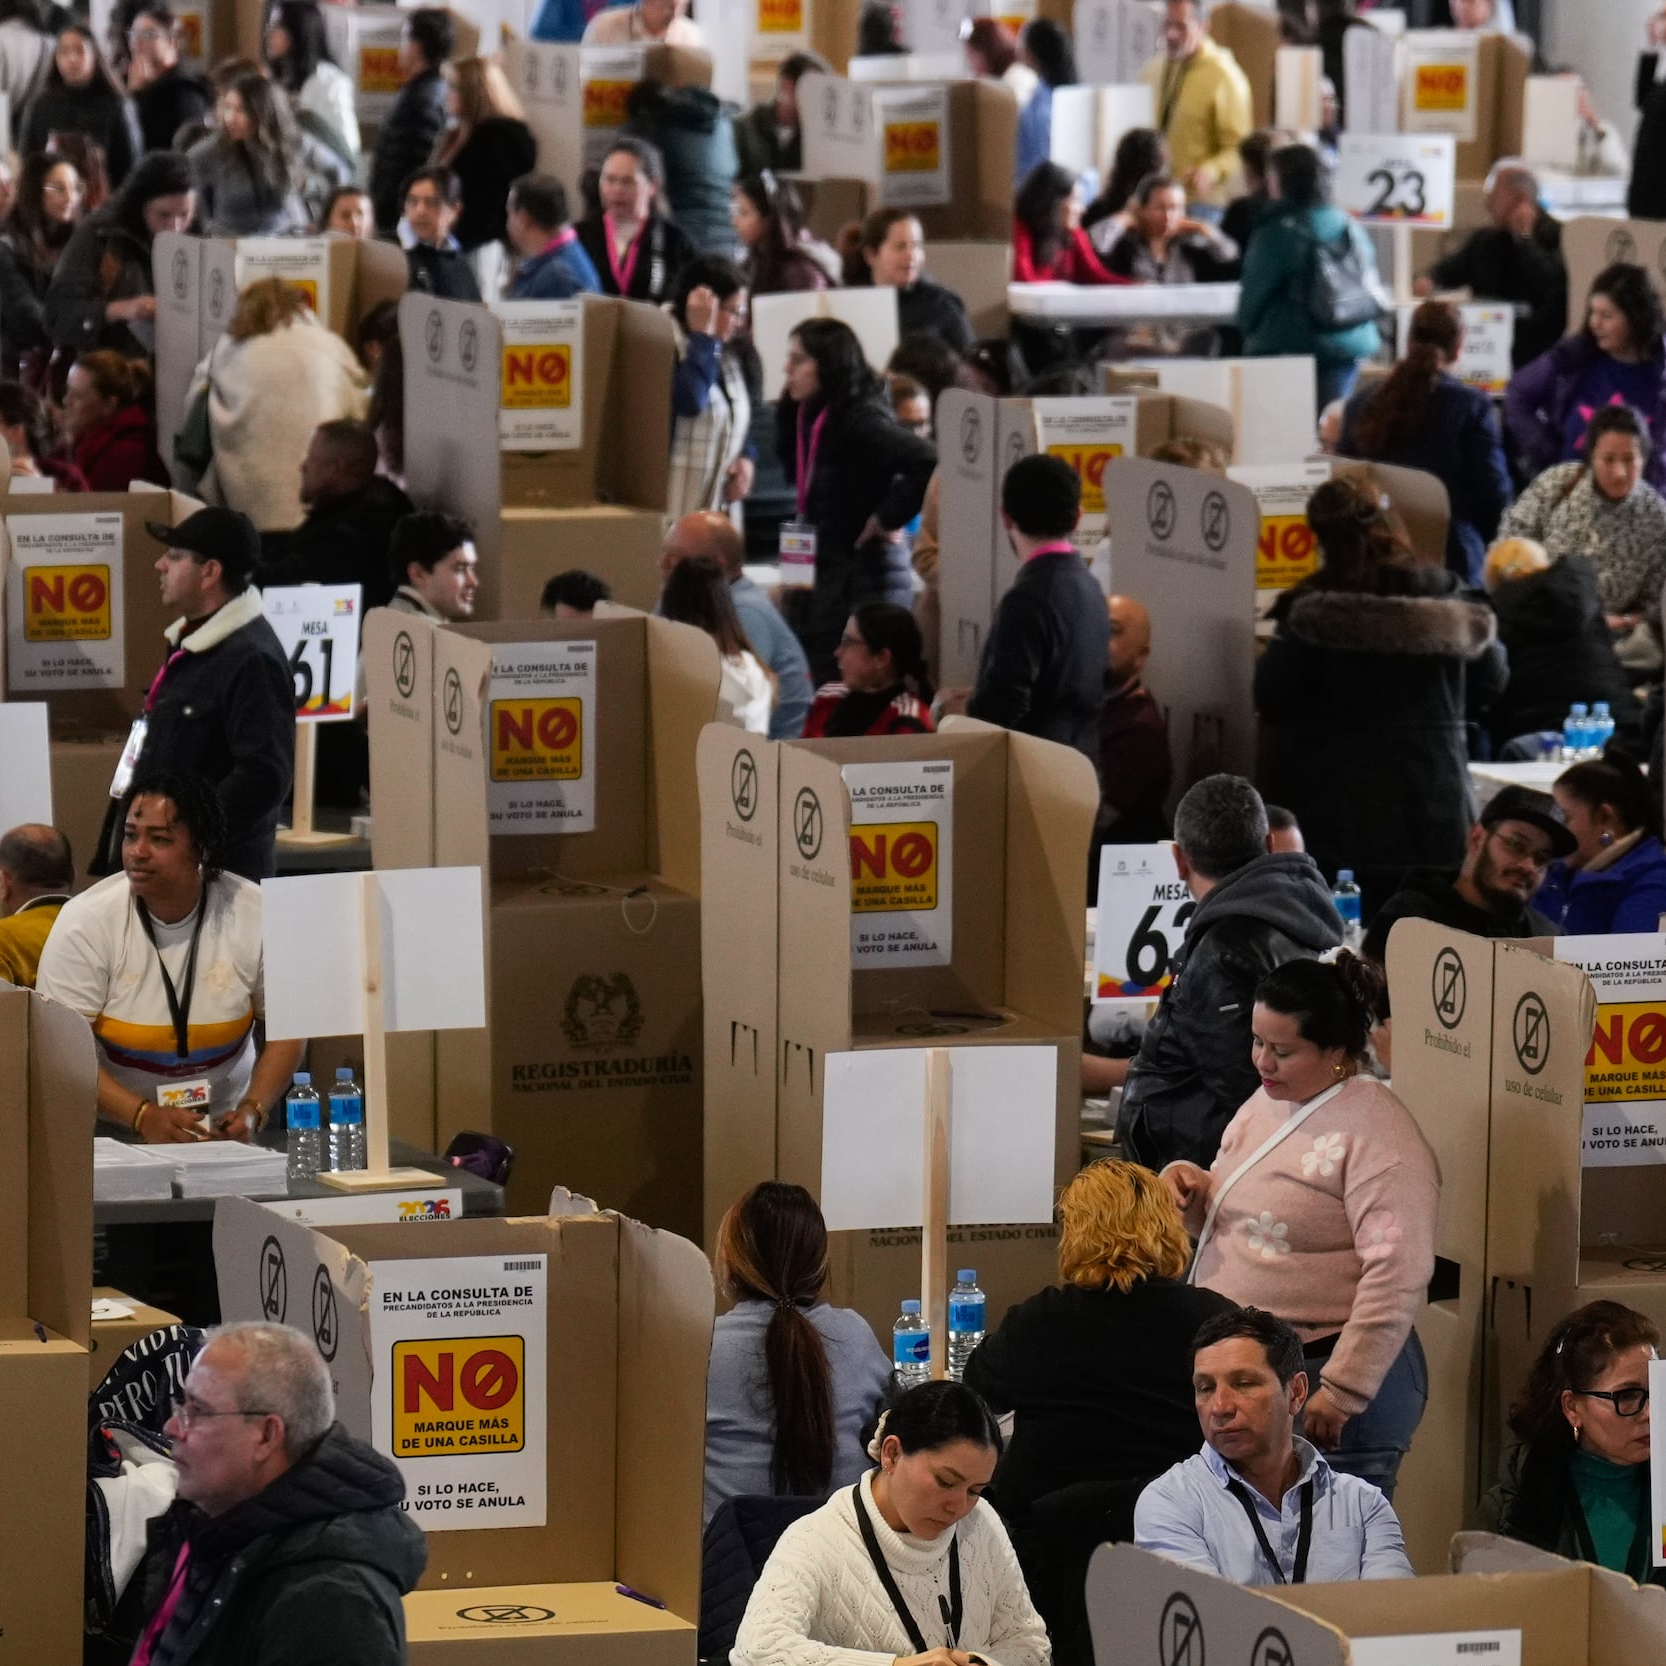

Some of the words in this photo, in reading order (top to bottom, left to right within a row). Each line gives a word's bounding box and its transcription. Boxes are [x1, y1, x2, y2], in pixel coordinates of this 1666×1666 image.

[1366, 168, 1426, 217] 23
[506, 350, 569, 385] NO
[29, 572, 109, 612] NO
[302, 622, 328, 635] MESA
[289, 639, 333, 709] 61
[497, 705, 578, 750] NO
[850, 828, 934, 877] NO
[1153, 884, 1190, 900] MESA
[1424, 1028, 1462, 1056] Prohibido
[1464, 1043, 1471, 1058] el
[512, 1054, 693, 1082] REGISTRADURÍA
[1505, 1078, 1521, 1094] uso
[1523, 1080, 1533, 1097] de
[1534, 1080, 1563, 1105] celular
[383, 1292, 402, 1302] EN
[408, 1291, 425, 1301] LA
[431, 1288, 508, 1300] CONSULTA
[515, 1286, 533, 1296] DE
[404, 1350, 518, 1413] NO
[414, 1421, 473, 1432] MARQUE
[479, 1418, 509, 1429] MÁS
[402, 1438, 419, 1448] DE
[426, 1437, 454, 1447] UNA
[460, 1434, 518, 1446] CASILLA
